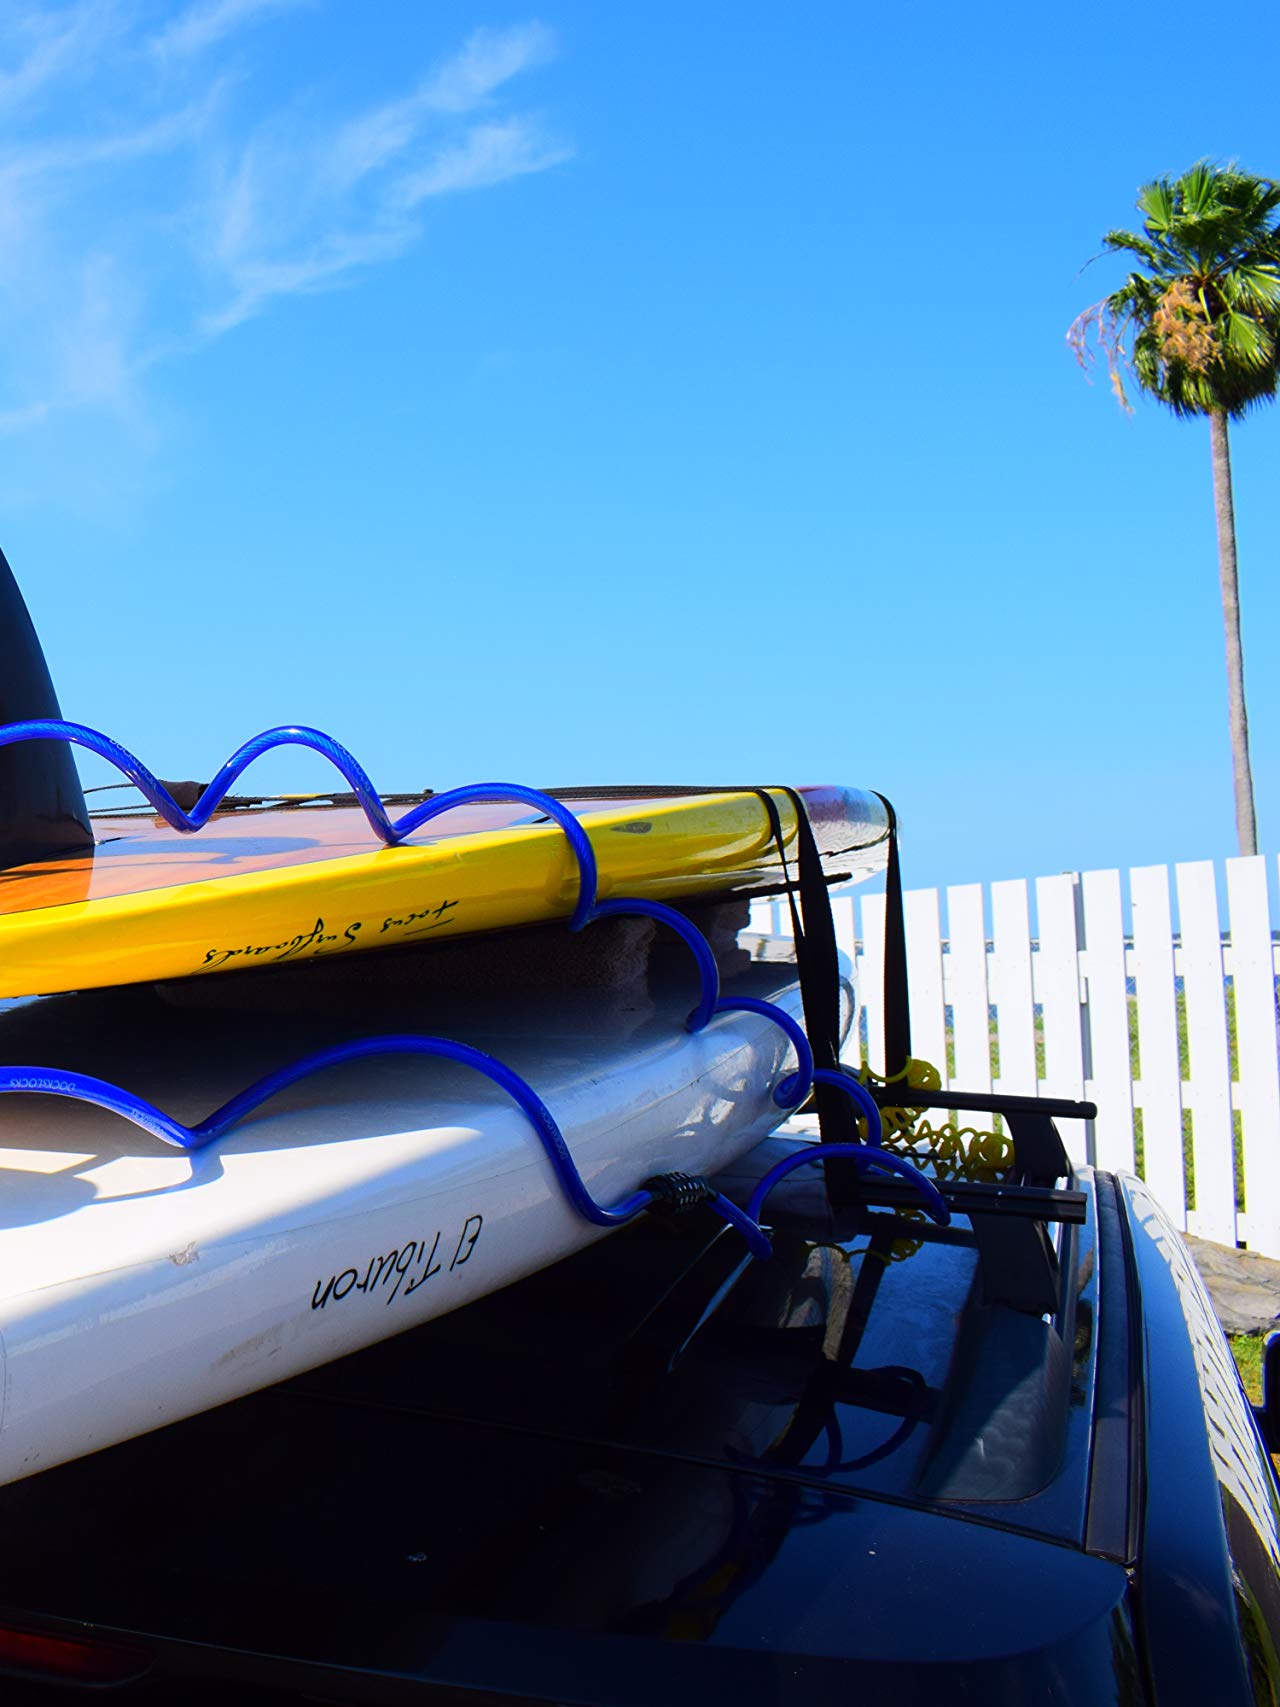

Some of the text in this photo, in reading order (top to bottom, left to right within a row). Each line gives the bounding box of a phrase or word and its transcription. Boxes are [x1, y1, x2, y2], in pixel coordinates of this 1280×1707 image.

[191, 916, 361, 975] Surfboards
[311, 1214, 483, 1310] El Tiburon
